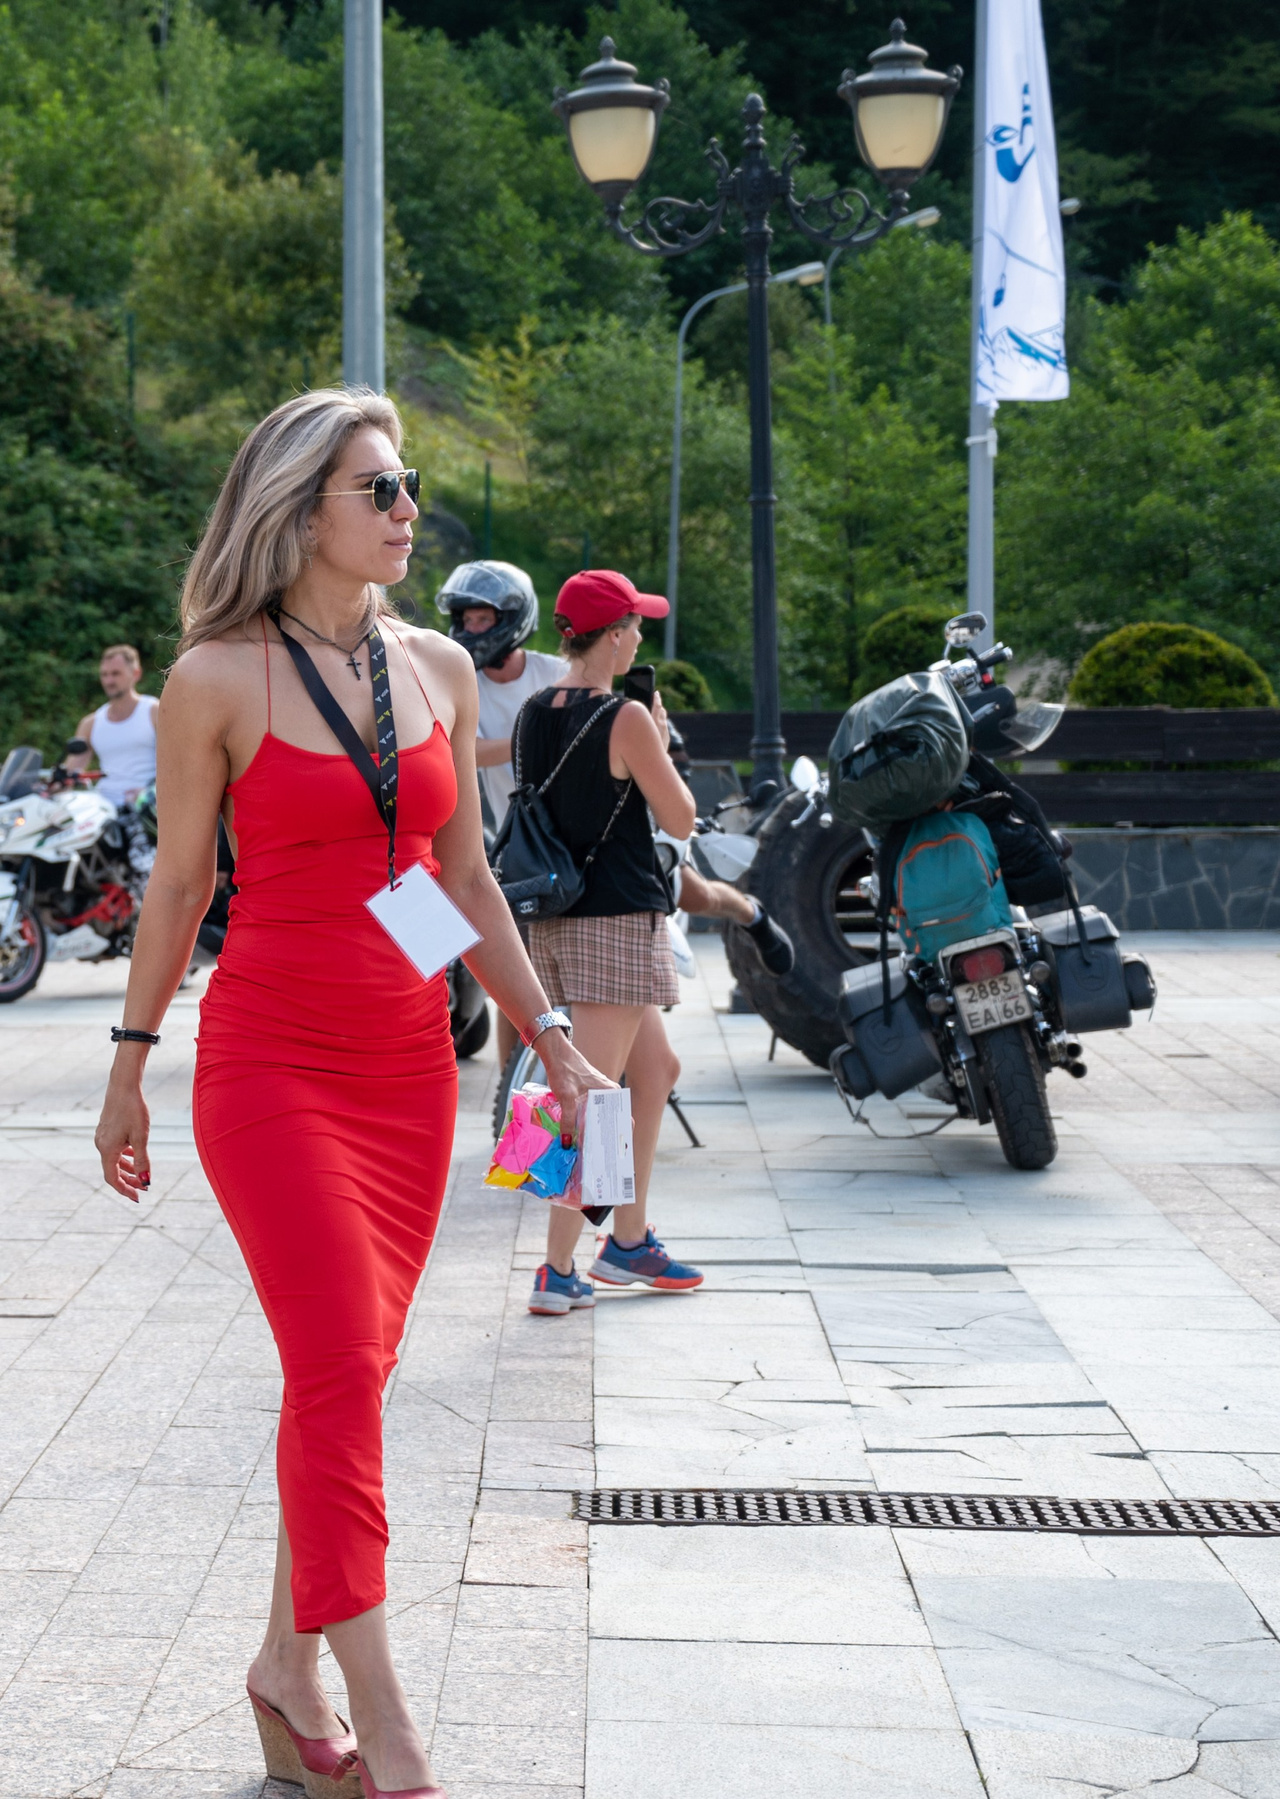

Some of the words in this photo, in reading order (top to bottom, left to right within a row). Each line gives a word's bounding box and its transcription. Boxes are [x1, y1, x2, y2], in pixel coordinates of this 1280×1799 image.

[965, 976, 1012, 1003] 2883
[966, 1008, 997, 1029] EA
[1002, 1000, 1026, 1020] 66
